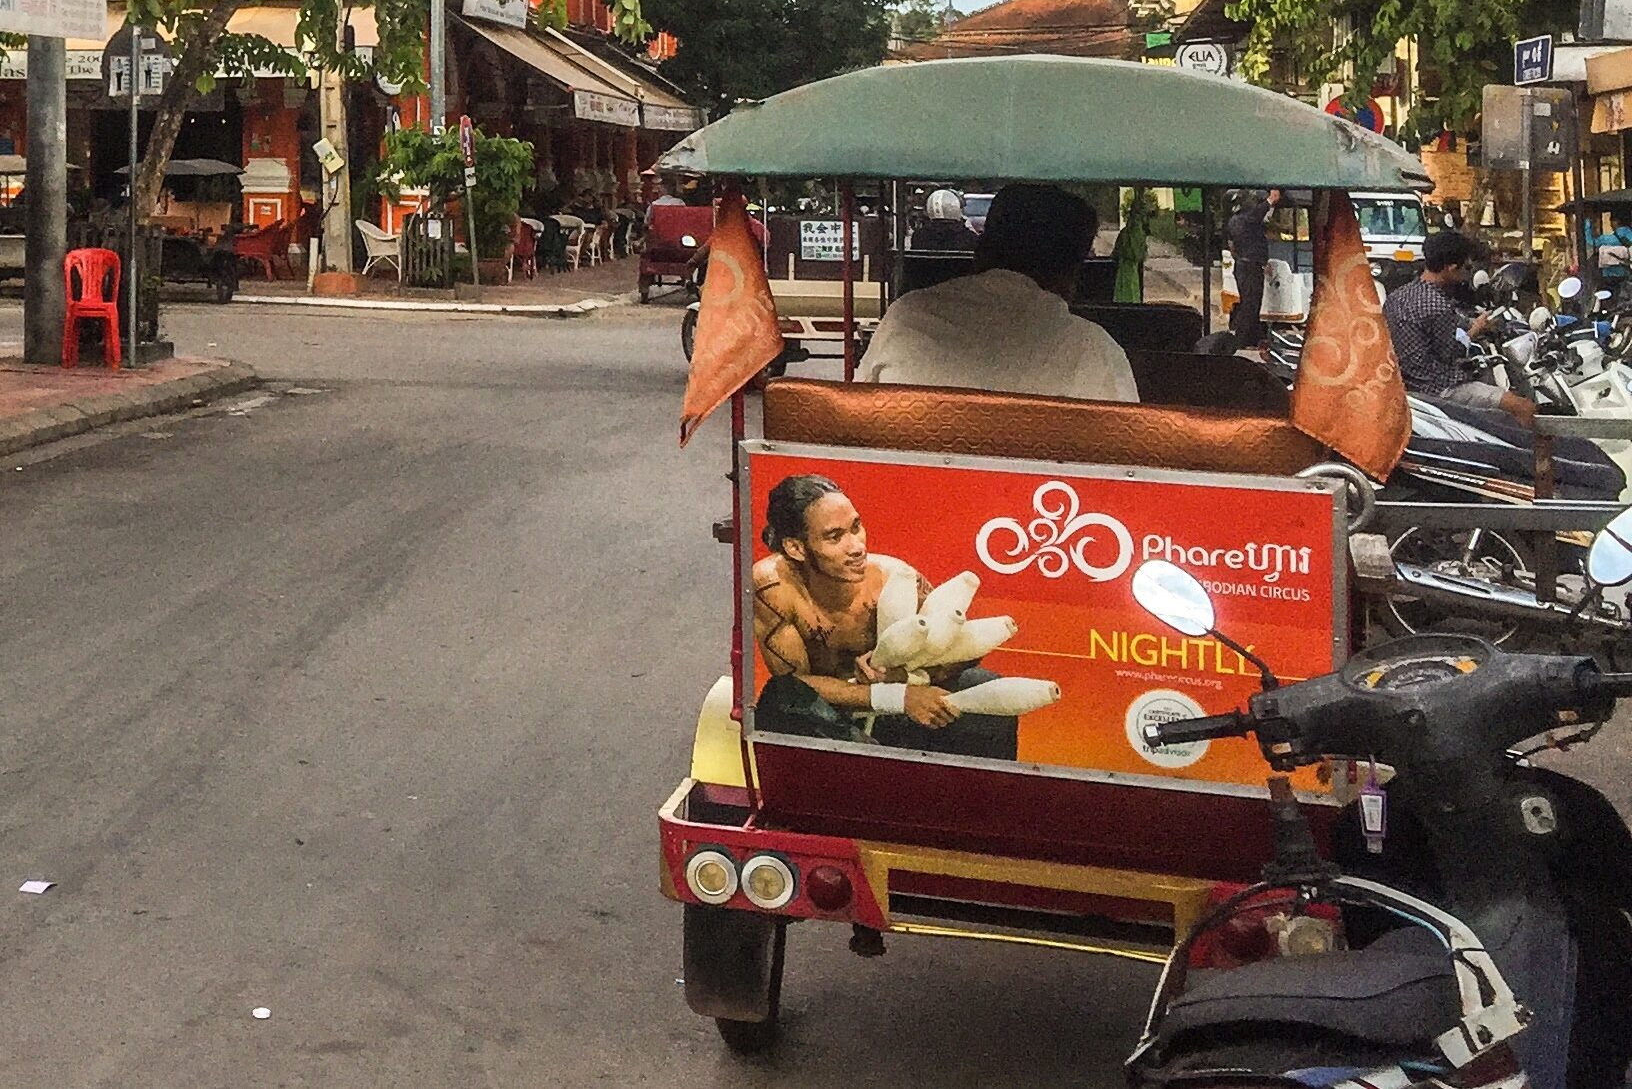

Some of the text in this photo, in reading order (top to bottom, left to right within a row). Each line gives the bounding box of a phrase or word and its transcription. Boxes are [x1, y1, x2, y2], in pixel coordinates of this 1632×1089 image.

[1142, 534, 1244, 569] Phare
[1260, 585, 1310, 602] CIRCUS
[1090, 628, 1257, 676] NIGHTLY
